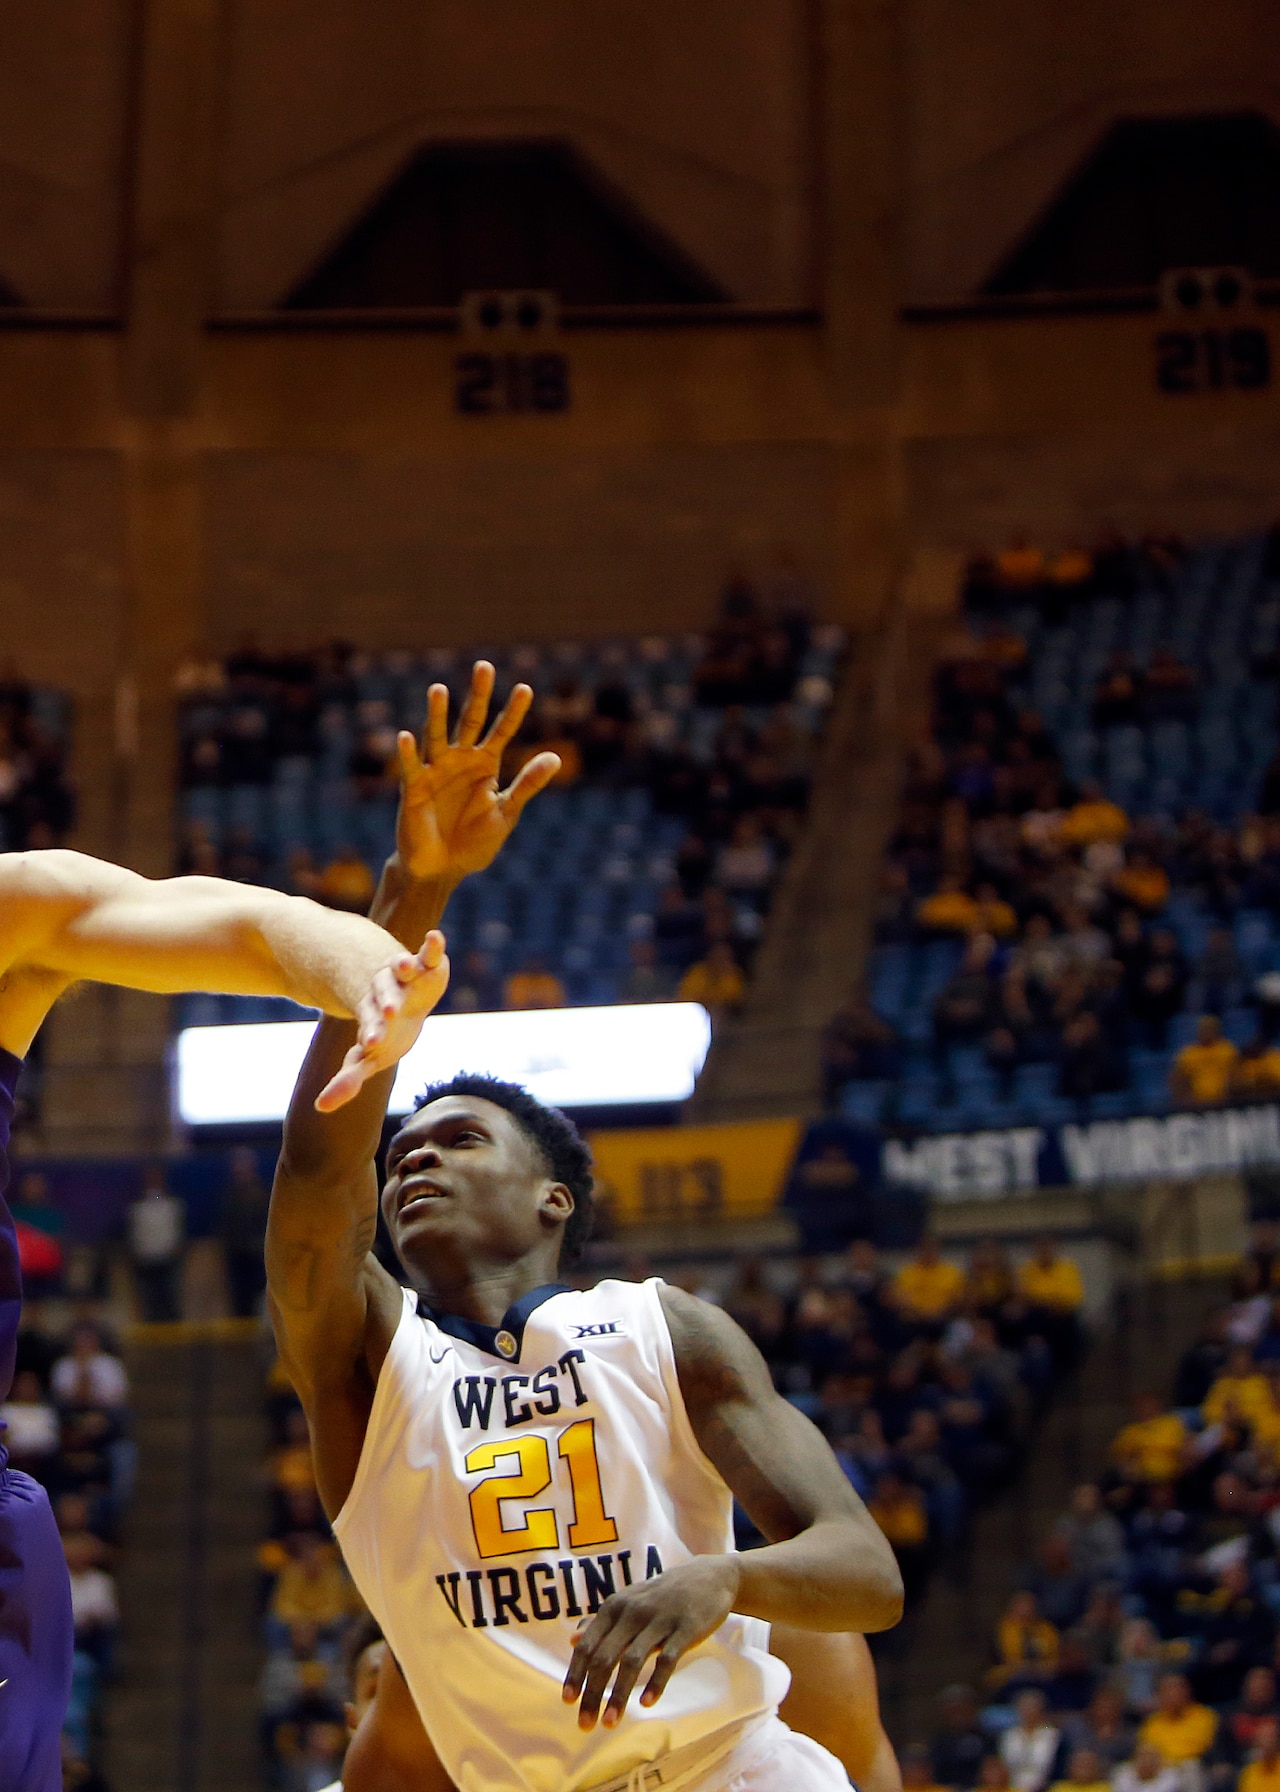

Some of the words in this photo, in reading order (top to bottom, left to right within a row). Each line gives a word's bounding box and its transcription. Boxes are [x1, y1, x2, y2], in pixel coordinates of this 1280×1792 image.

[457, 354, 570, 413] 218
[1157, 328, 1269, 391] 219
[883, 1126, 1046, 1200] WEST
[453, 1349, 588, 1431] WEST
[464, 1418, 619, 1559] 21
